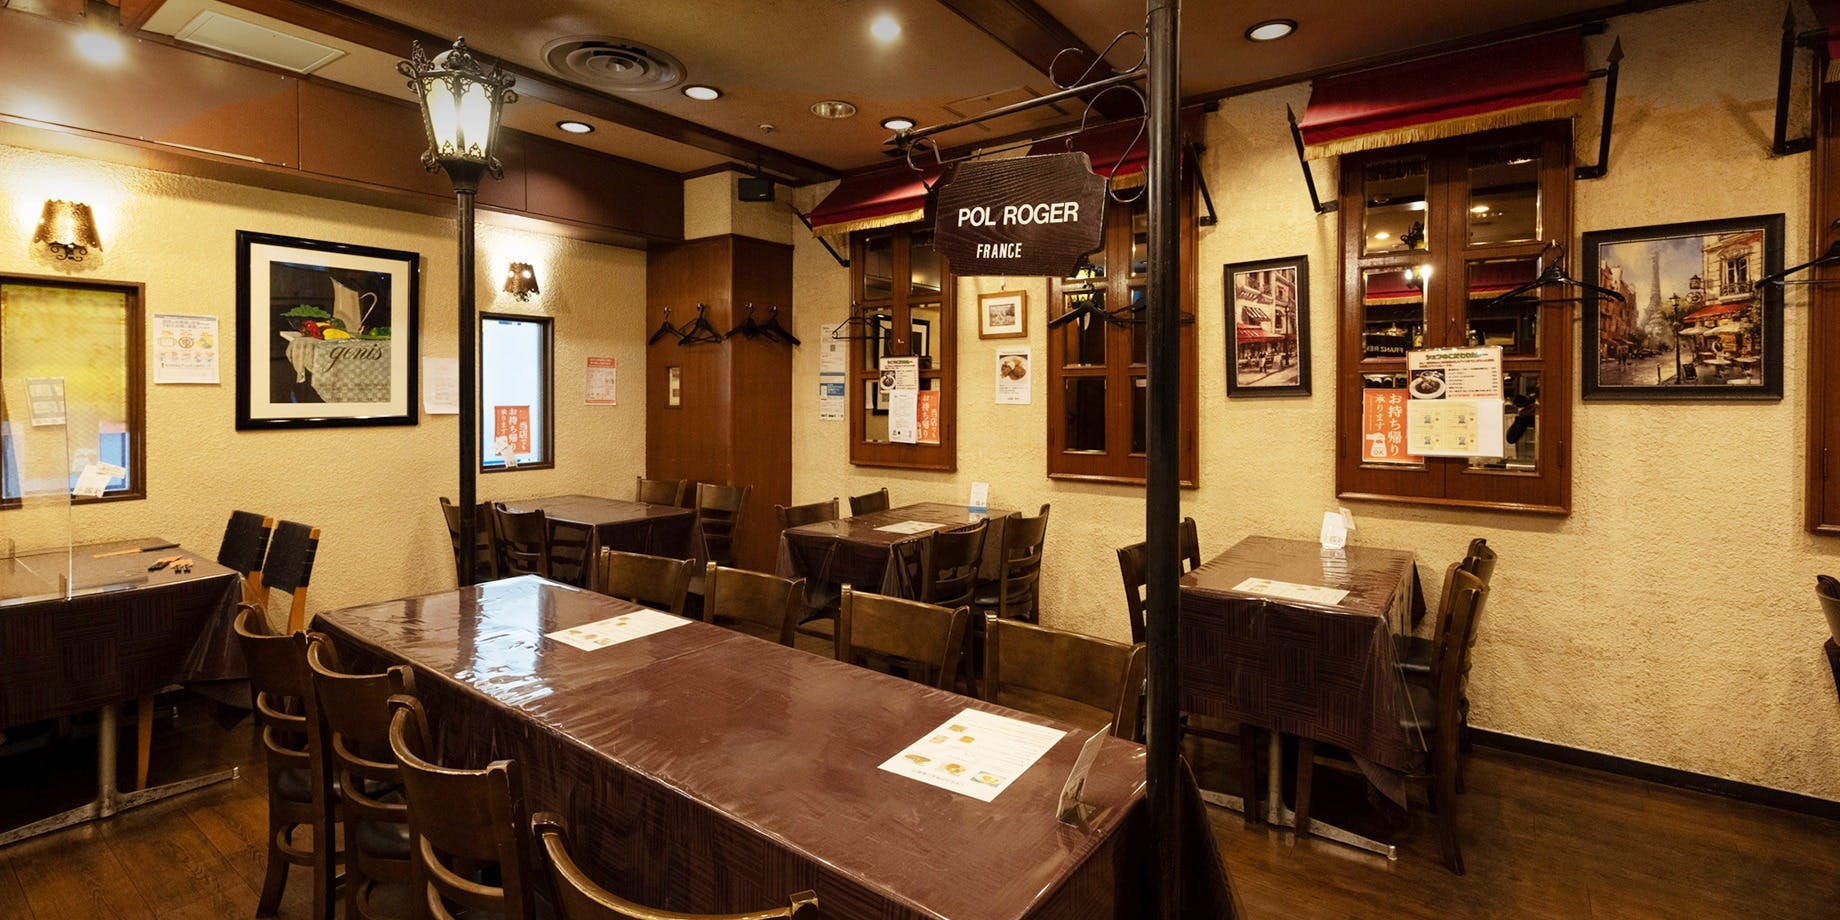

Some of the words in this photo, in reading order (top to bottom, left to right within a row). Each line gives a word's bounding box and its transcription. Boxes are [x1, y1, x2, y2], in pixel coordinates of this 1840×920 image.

[958, 206, 996, 227] POL
[1003, 201, 1079, 225] ROGER
[976, 242, 1022, 258] FRANCE
[1388, 394, 1402, 456] お持ち帰り
